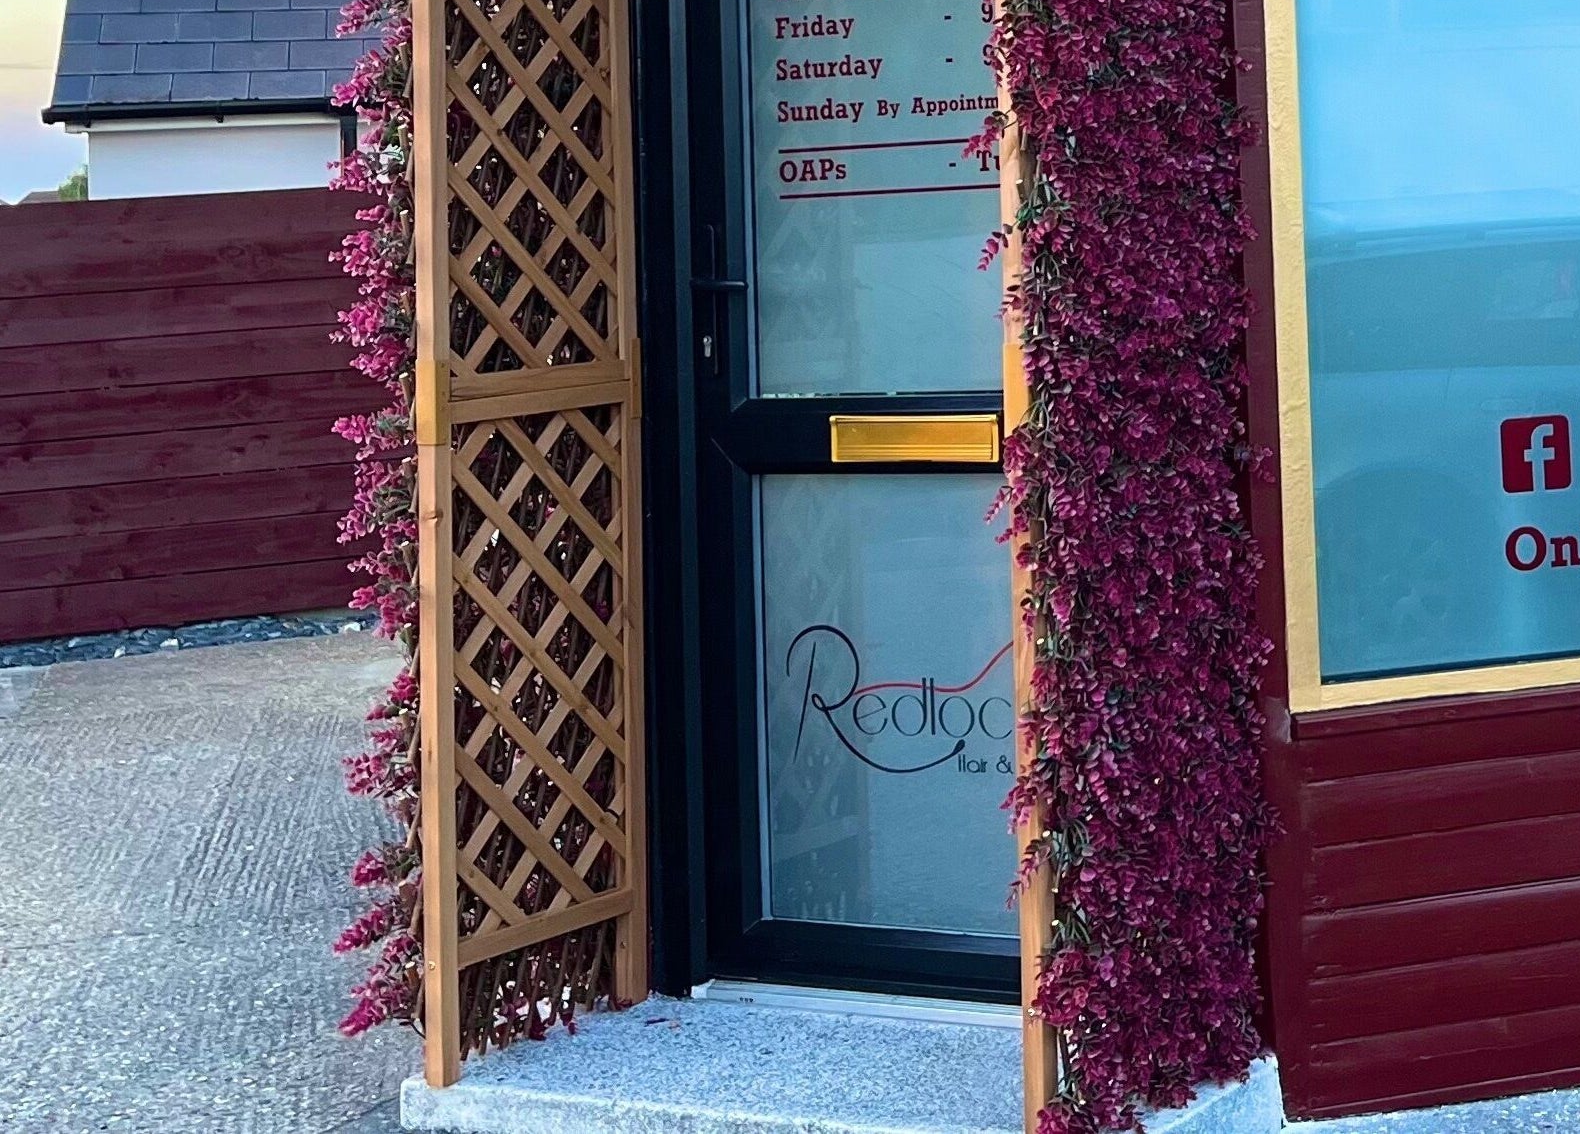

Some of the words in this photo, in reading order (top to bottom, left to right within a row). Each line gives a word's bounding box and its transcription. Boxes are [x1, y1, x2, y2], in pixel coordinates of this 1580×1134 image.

[775, 15, 855, 39] Friday
[776, 57, 882, 82] Saturday
[778, 98, 865, 123] Sunday
[877, 100, 900, 119] By
[911, 95, 999, 117] Appointm
[779, 160, 847, 183] OAPs
[786, 624, 1012, 774] Redloc
